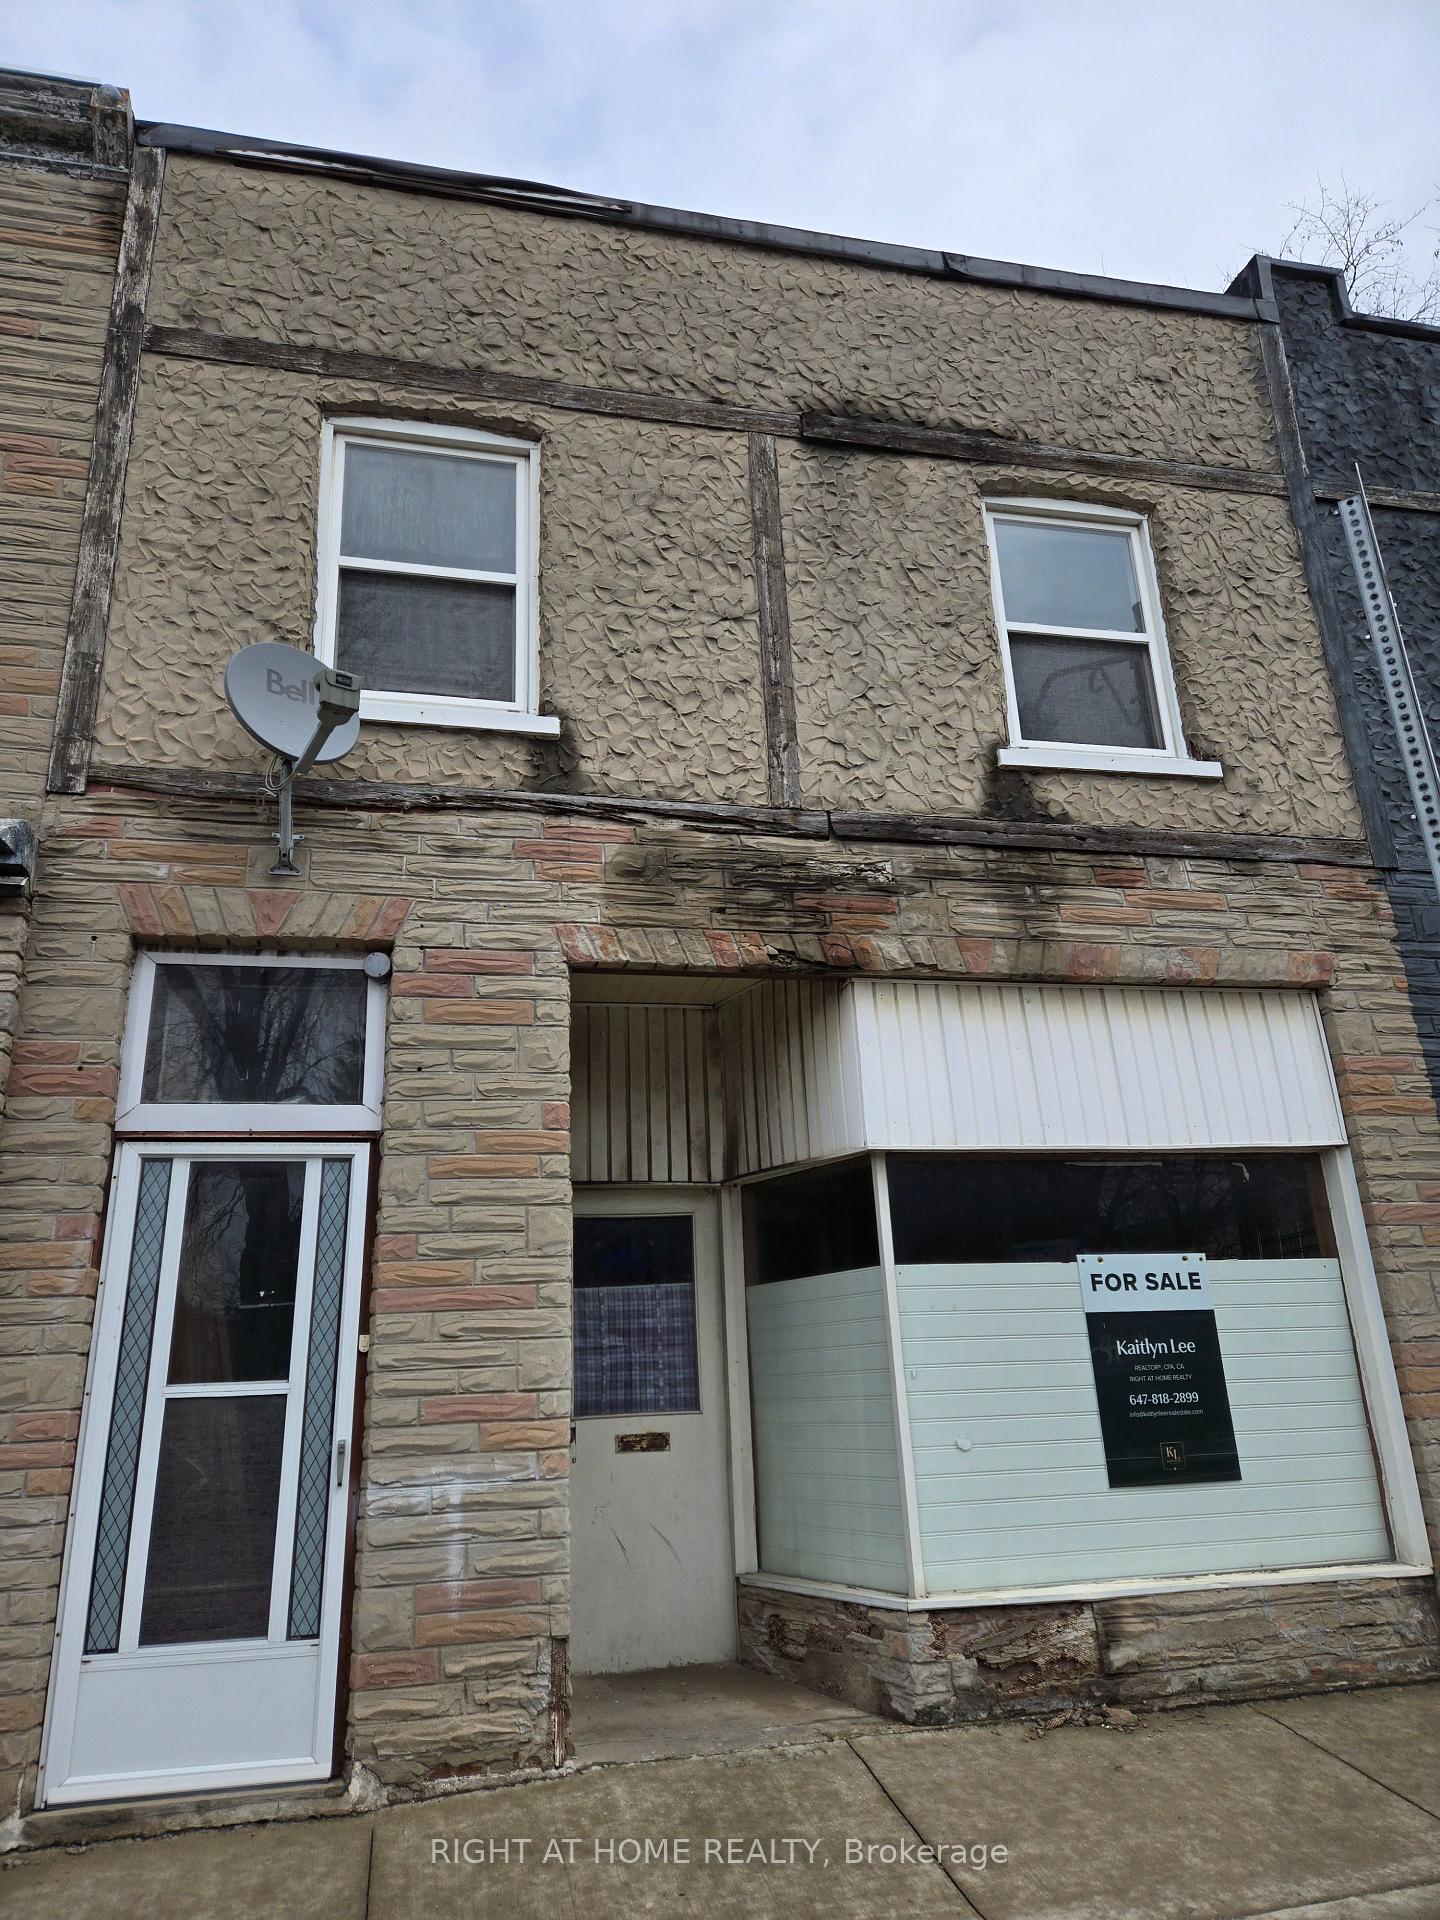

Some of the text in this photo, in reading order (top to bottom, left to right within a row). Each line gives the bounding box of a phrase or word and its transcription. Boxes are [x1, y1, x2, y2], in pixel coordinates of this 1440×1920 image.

[266, 667, 315, 705] Bell
[1090, 1272, 1202, 1292] FOR SALE
[1116, 1338, 1196, 1359] Kaitlyn Lee
[1129, 1392, 1199, 1405] 647-818-2899
